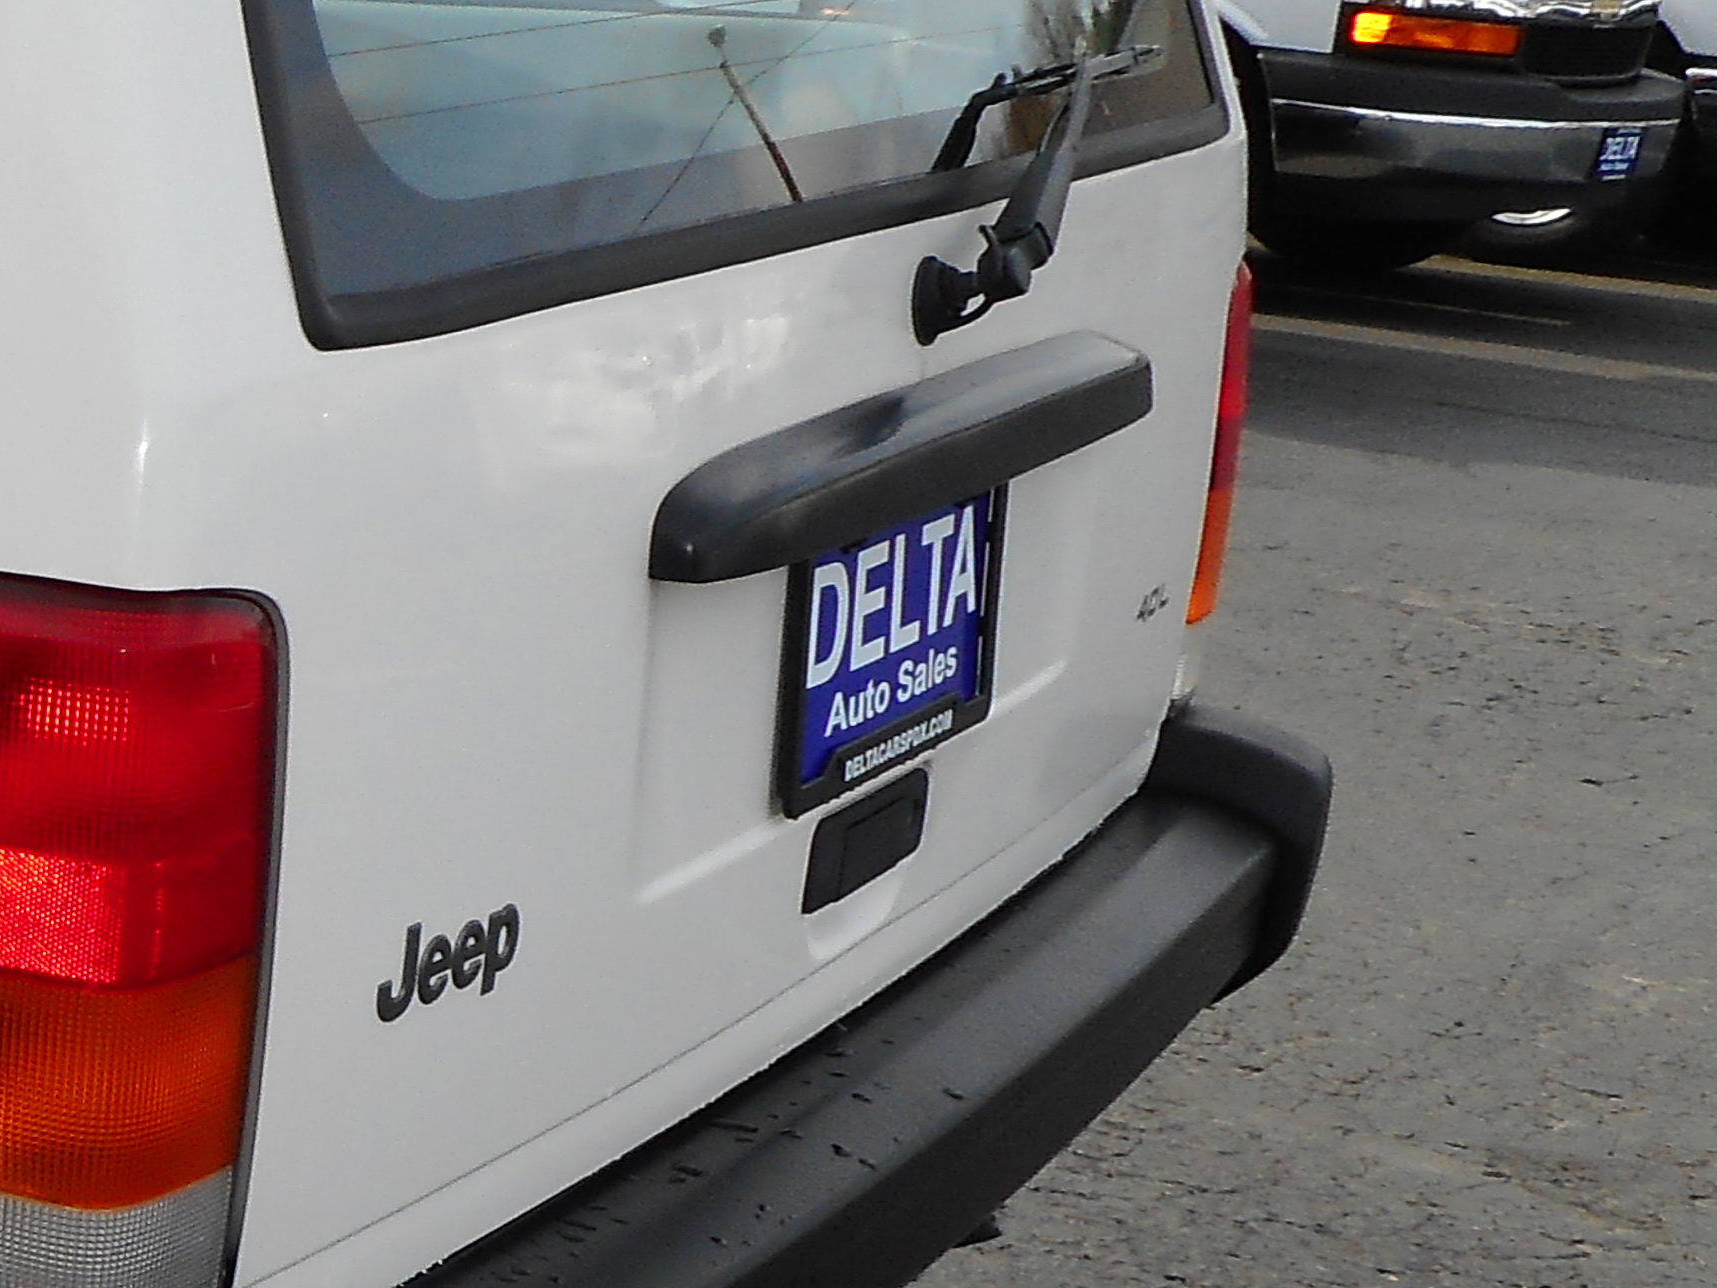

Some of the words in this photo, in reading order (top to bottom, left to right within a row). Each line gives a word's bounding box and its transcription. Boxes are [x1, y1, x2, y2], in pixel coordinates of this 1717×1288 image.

[806, 505, 976, 690] DELTA
[824, 680, 890, 738] Auto
[897, 645, 958, 702] Sales
[376, 903, 520, 1024] Jeep
